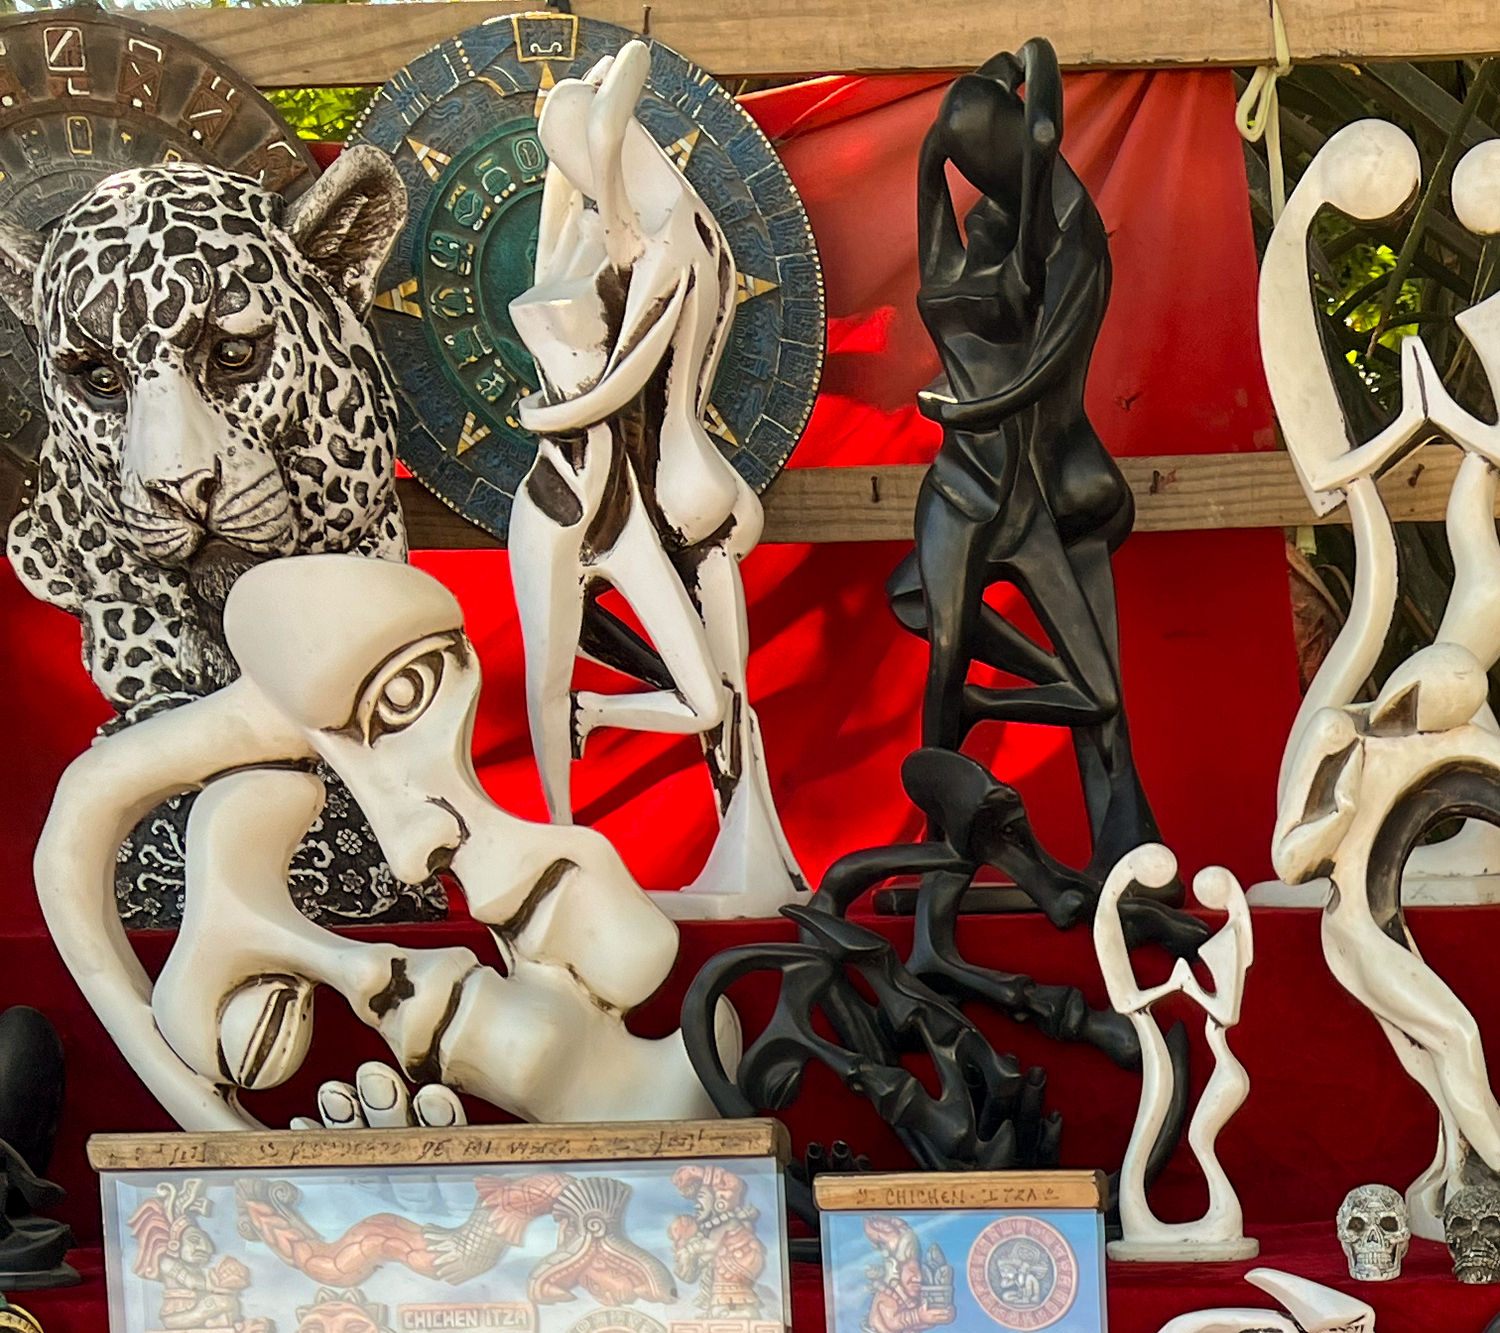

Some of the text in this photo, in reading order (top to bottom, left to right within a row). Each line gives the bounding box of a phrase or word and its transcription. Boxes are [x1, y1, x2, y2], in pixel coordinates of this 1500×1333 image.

[885, 1187, 965, 1206] CHICHEN
[402, 1308, 528, 1330] CHICHEN ITZA
